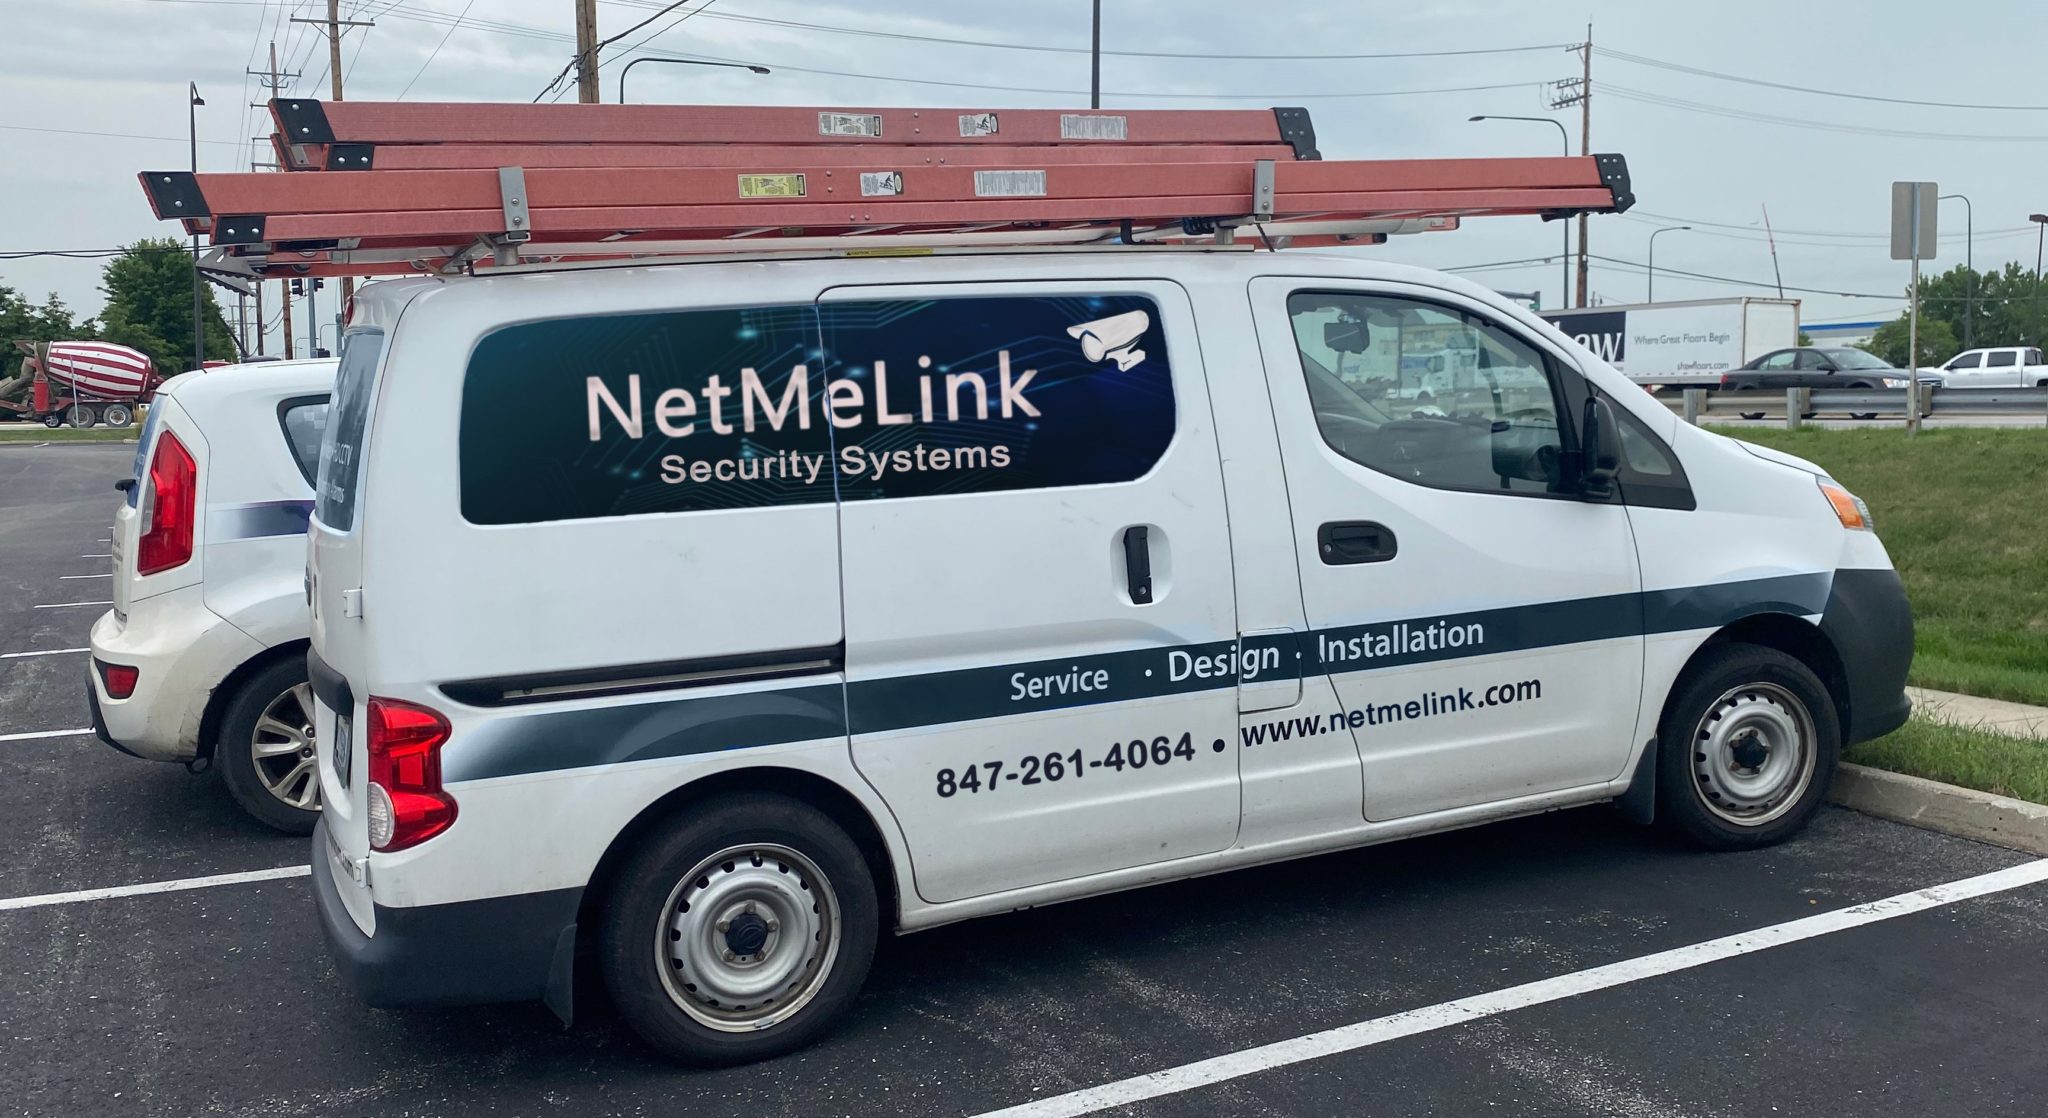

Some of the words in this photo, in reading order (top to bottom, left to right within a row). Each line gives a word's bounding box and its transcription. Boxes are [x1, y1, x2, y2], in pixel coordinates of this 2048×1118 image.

[1634, 335, 1659, 345] Where
[1660, 334, 1680, 344] Great
[1683, 333, 1707, 343] Floors
[1709, 332, 1730, 345] Begin
[1677, 361, 1729, 371] shawfloors.com
[586, 350, 1042, 441] NetMeLink
[660, 450, 824, 484] Security
[840, 443, 1011, 481] Systems
[1010, 665, 1109, 700] Service
[1168, 646, 1279, 682] Design
[1318, 620, 1484, 663] Installation
[936, 731, 1196, 798] 847-261-4064
[1240, 679, 1542, 748] www.netmelink.com
